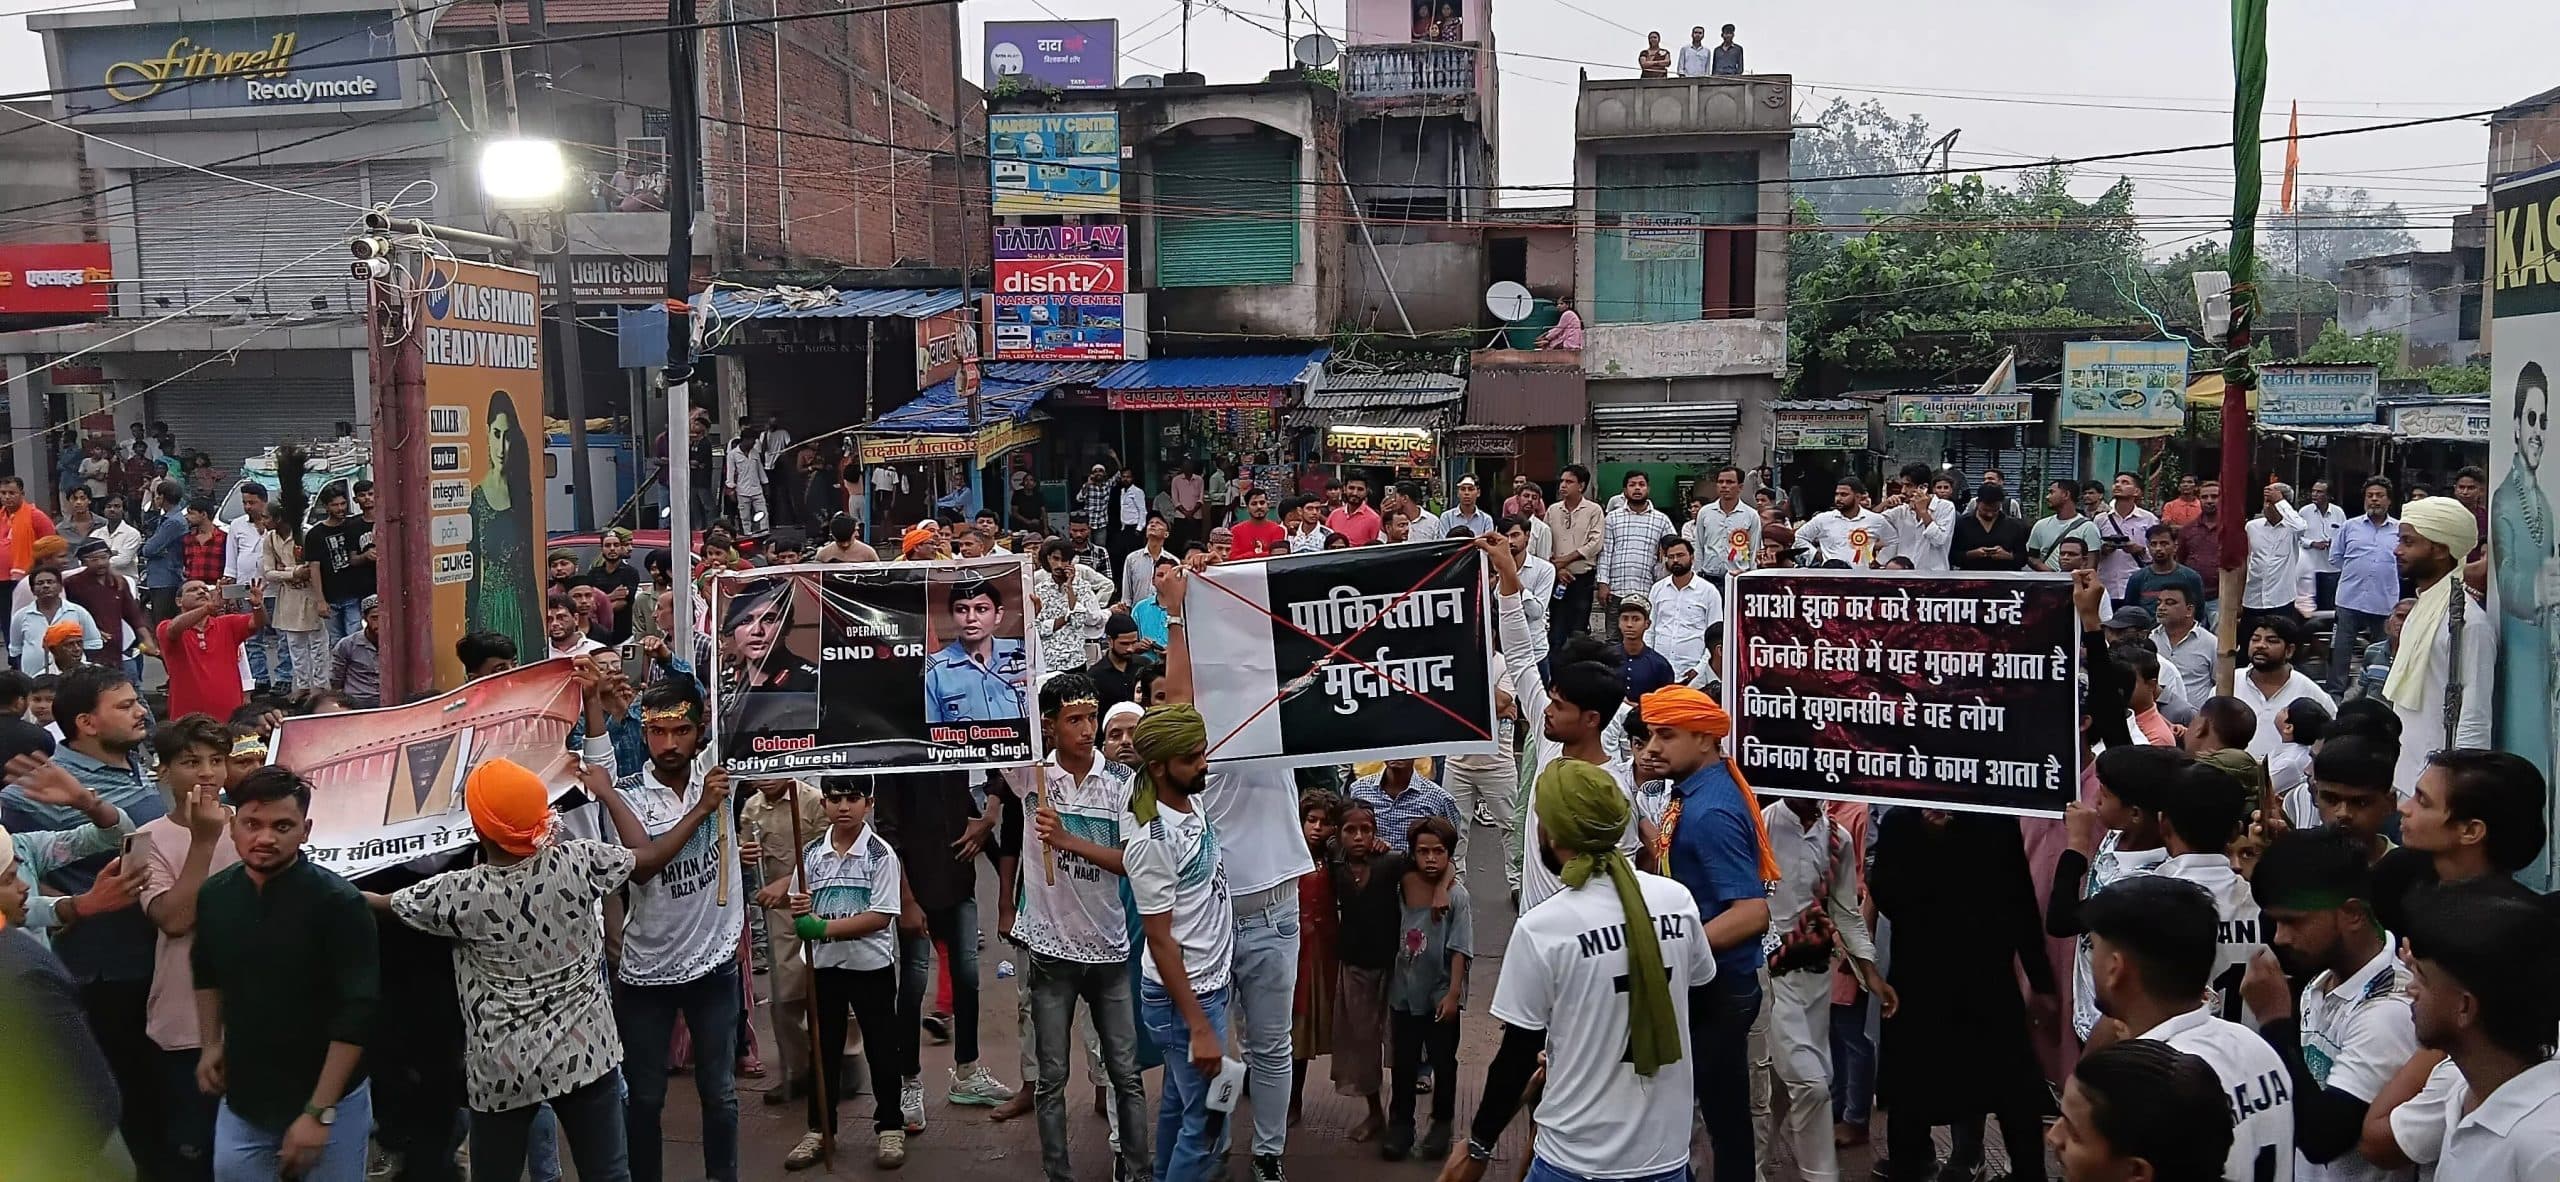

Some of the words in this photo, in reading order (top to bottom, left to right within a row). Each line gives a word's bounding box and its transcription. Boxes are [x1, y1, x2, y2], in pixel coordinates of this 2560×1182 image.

[1037, 39, 1063, 51] टाटा
[248, 76, 377, 101] Readymade
[1046, 118, 1061, 132] TV
[1064, 117, 1115, 132] CENTER
[996, 227, 1056, 250] TATA
[1061, 226, 1121, 249] PLAY
[571, 262, 611, 284] LIGHT
[612, 265, 621, 284] &
[623, 261, 668, 283] SOUN
[1003, 263, 1111, 293] dishtv
[453, 281, 536, 327] KASHMIR
[995, 295, 1047, 305] NARESH
[1052, 295, 1066, 305] TV
[1070, 294, 1121, 305] CENTER
[425, 326, 538, 370] READYMADE
[2309, 373, 2373, 384] मालाकार
[431, 410, 459, 432] KILLER
[1327, 434, 1370, 449] भारत
[433, 451, 456, 468] spykar
[442, 554, 472, 572] DUKE
[1288, 585, 1465, 635] पाकिस्तान
[1744, 586, 1795, 619] आओ
[1802, 595, 1840, 628] झुक
[1845, 596, 1875, 621] कर
[1878, 588, 1911, 622] करे
[1916, 597, 1977, 624] सलाम
[1983, 590, 2024, 626] उन्हें
[846, 623, 899, 638] OPERATION
[1750, 636, 1808, 669] जिनके
[1813, 638, 1860, 672] हिस्से
[1865, 640, 1883, 673] में
[1888, 650, 1918, 675] यह
[1923, 650, 1985, 684] मुकाम
[1991, 653, 2045, 680] आता
[2050, 646, 2067, 682] है
[1321, 646, 1454, 715] मुर्दाबाद
[1743, 685, 1798, 720] कितने
[1802, 692, 1897, 731] खुशनसीब
[1901, 692, 1917, 727] है
[1922, 702, 1953, 729] वह
[1959, 696, 2005, 732] लोग
[753, 734, 815, 752] Colonel
[930, 726, 967, 744] Wing
[970, 726, 1018, 741] Comm.
[726, 756, 779, 772] Sofiya
[784, 751, 848, 769] Qureshi
[926, 744, 986, 761] Vyomika
[991, 743, 1030, 760] Singh
[1743, 736, 1810, 771] जिनका
[1813, 748, 1850, 783] खून
[1856, 751, 1903, 778] वतन
[1907, 745, 1929, 780] के
[1934, 756, 1979, 784] काम
[1985, 760, 2040, 789] आता
[2045, 754, 2062, 790] है
[346, 834, 426, 862] संविधान
[431, 825, 451, 846] से
[661, 857, 701, 887] ARYAN
[670, 880, 697, 900] RAZA
[1577, 913, 1684, 959] MUAZ
